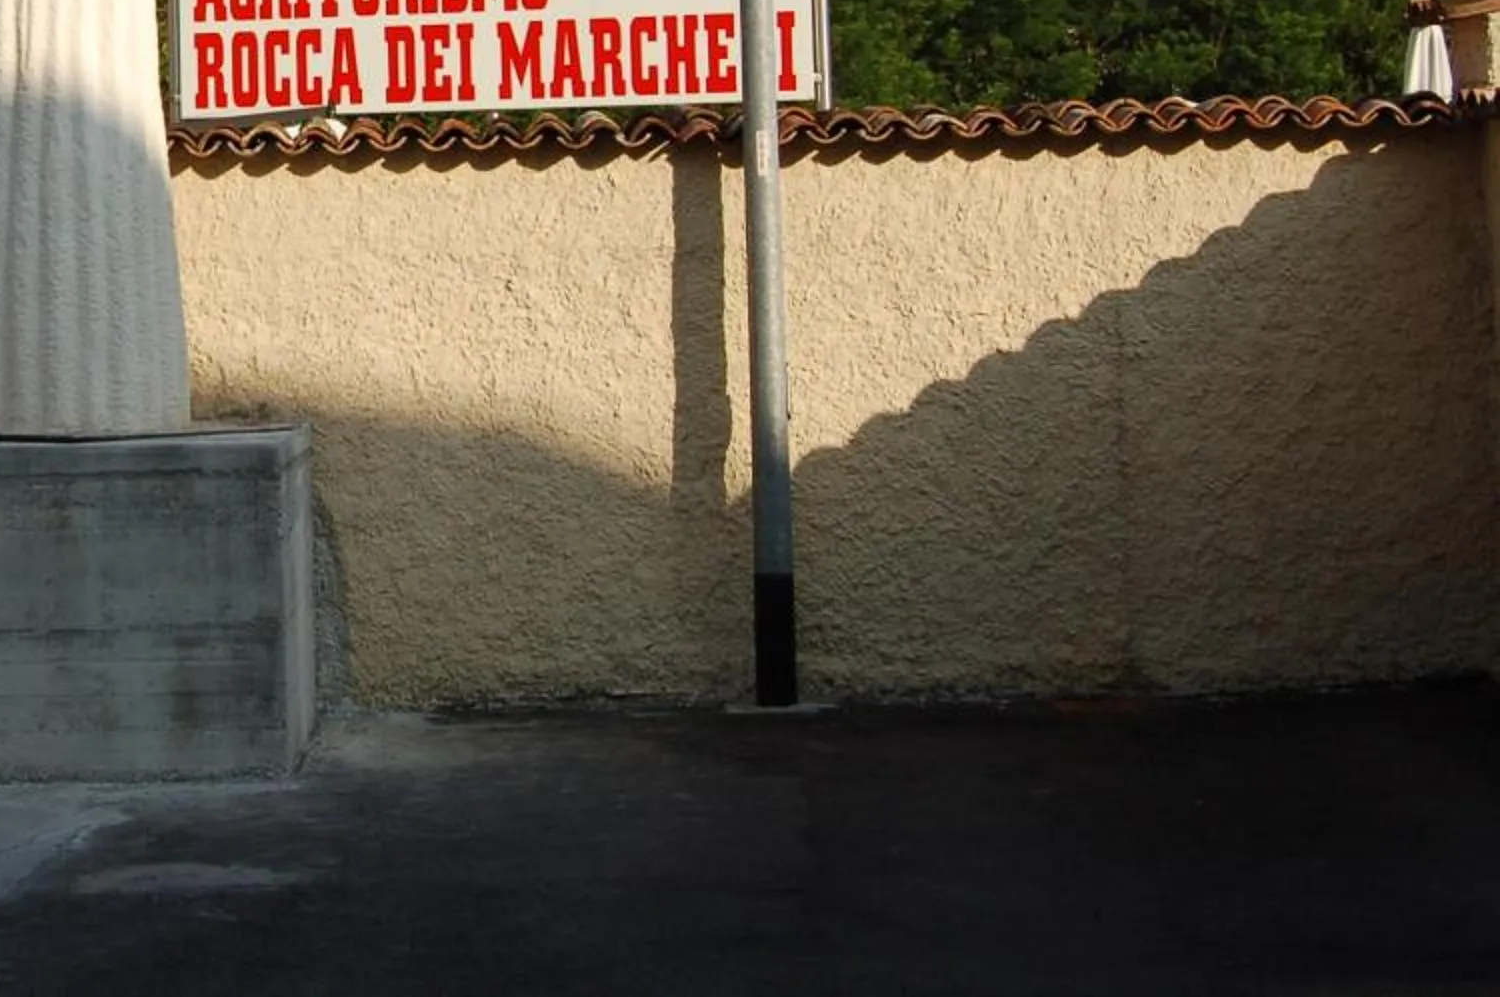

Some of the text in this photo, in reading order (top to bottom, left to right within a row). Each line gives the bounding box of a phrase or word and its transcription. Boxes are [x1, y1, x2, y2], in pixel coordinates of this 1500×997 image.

[194, 10, 797, 109] ROCCA DEI MARCHEI
